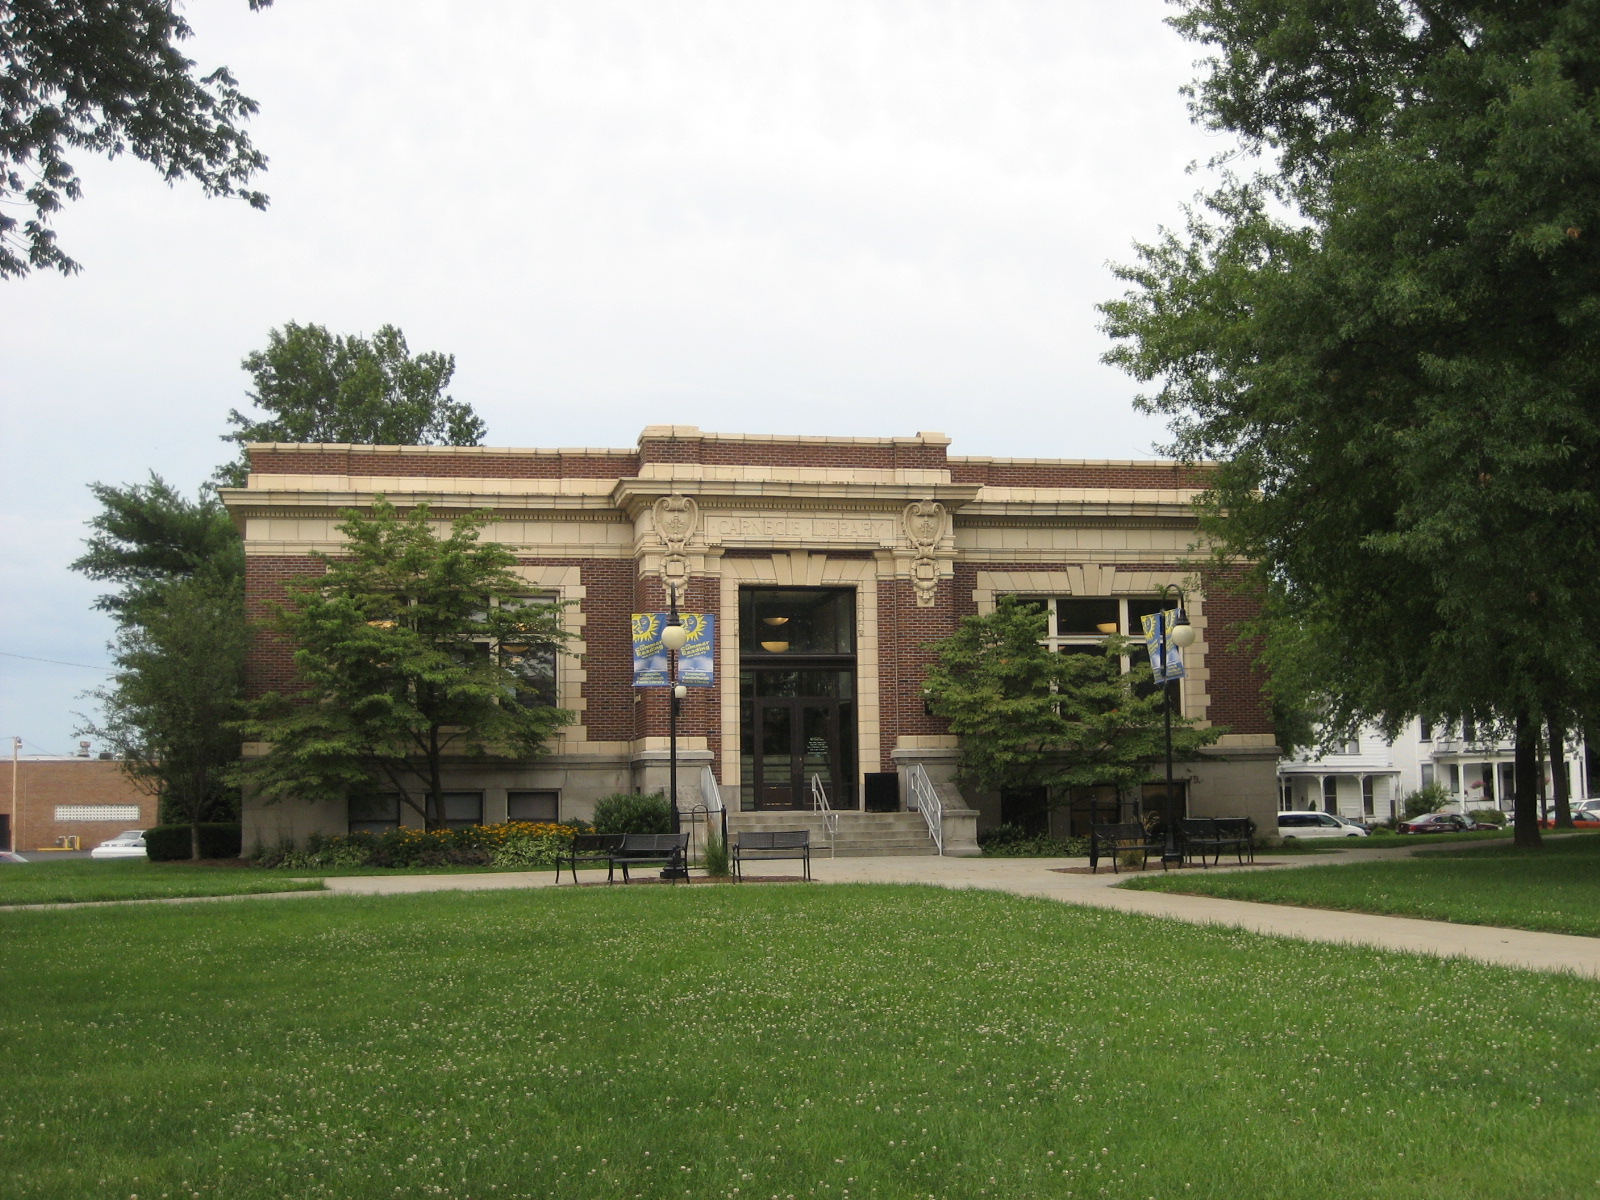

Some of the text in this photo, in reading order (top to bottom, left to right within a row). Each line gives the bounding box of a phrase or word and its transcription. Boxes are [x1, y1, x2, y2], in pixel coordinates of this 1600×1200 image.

[718, 520, 884, 537] CARNEGIE LIBRARY
[680, 640, 710, 652] Summer
